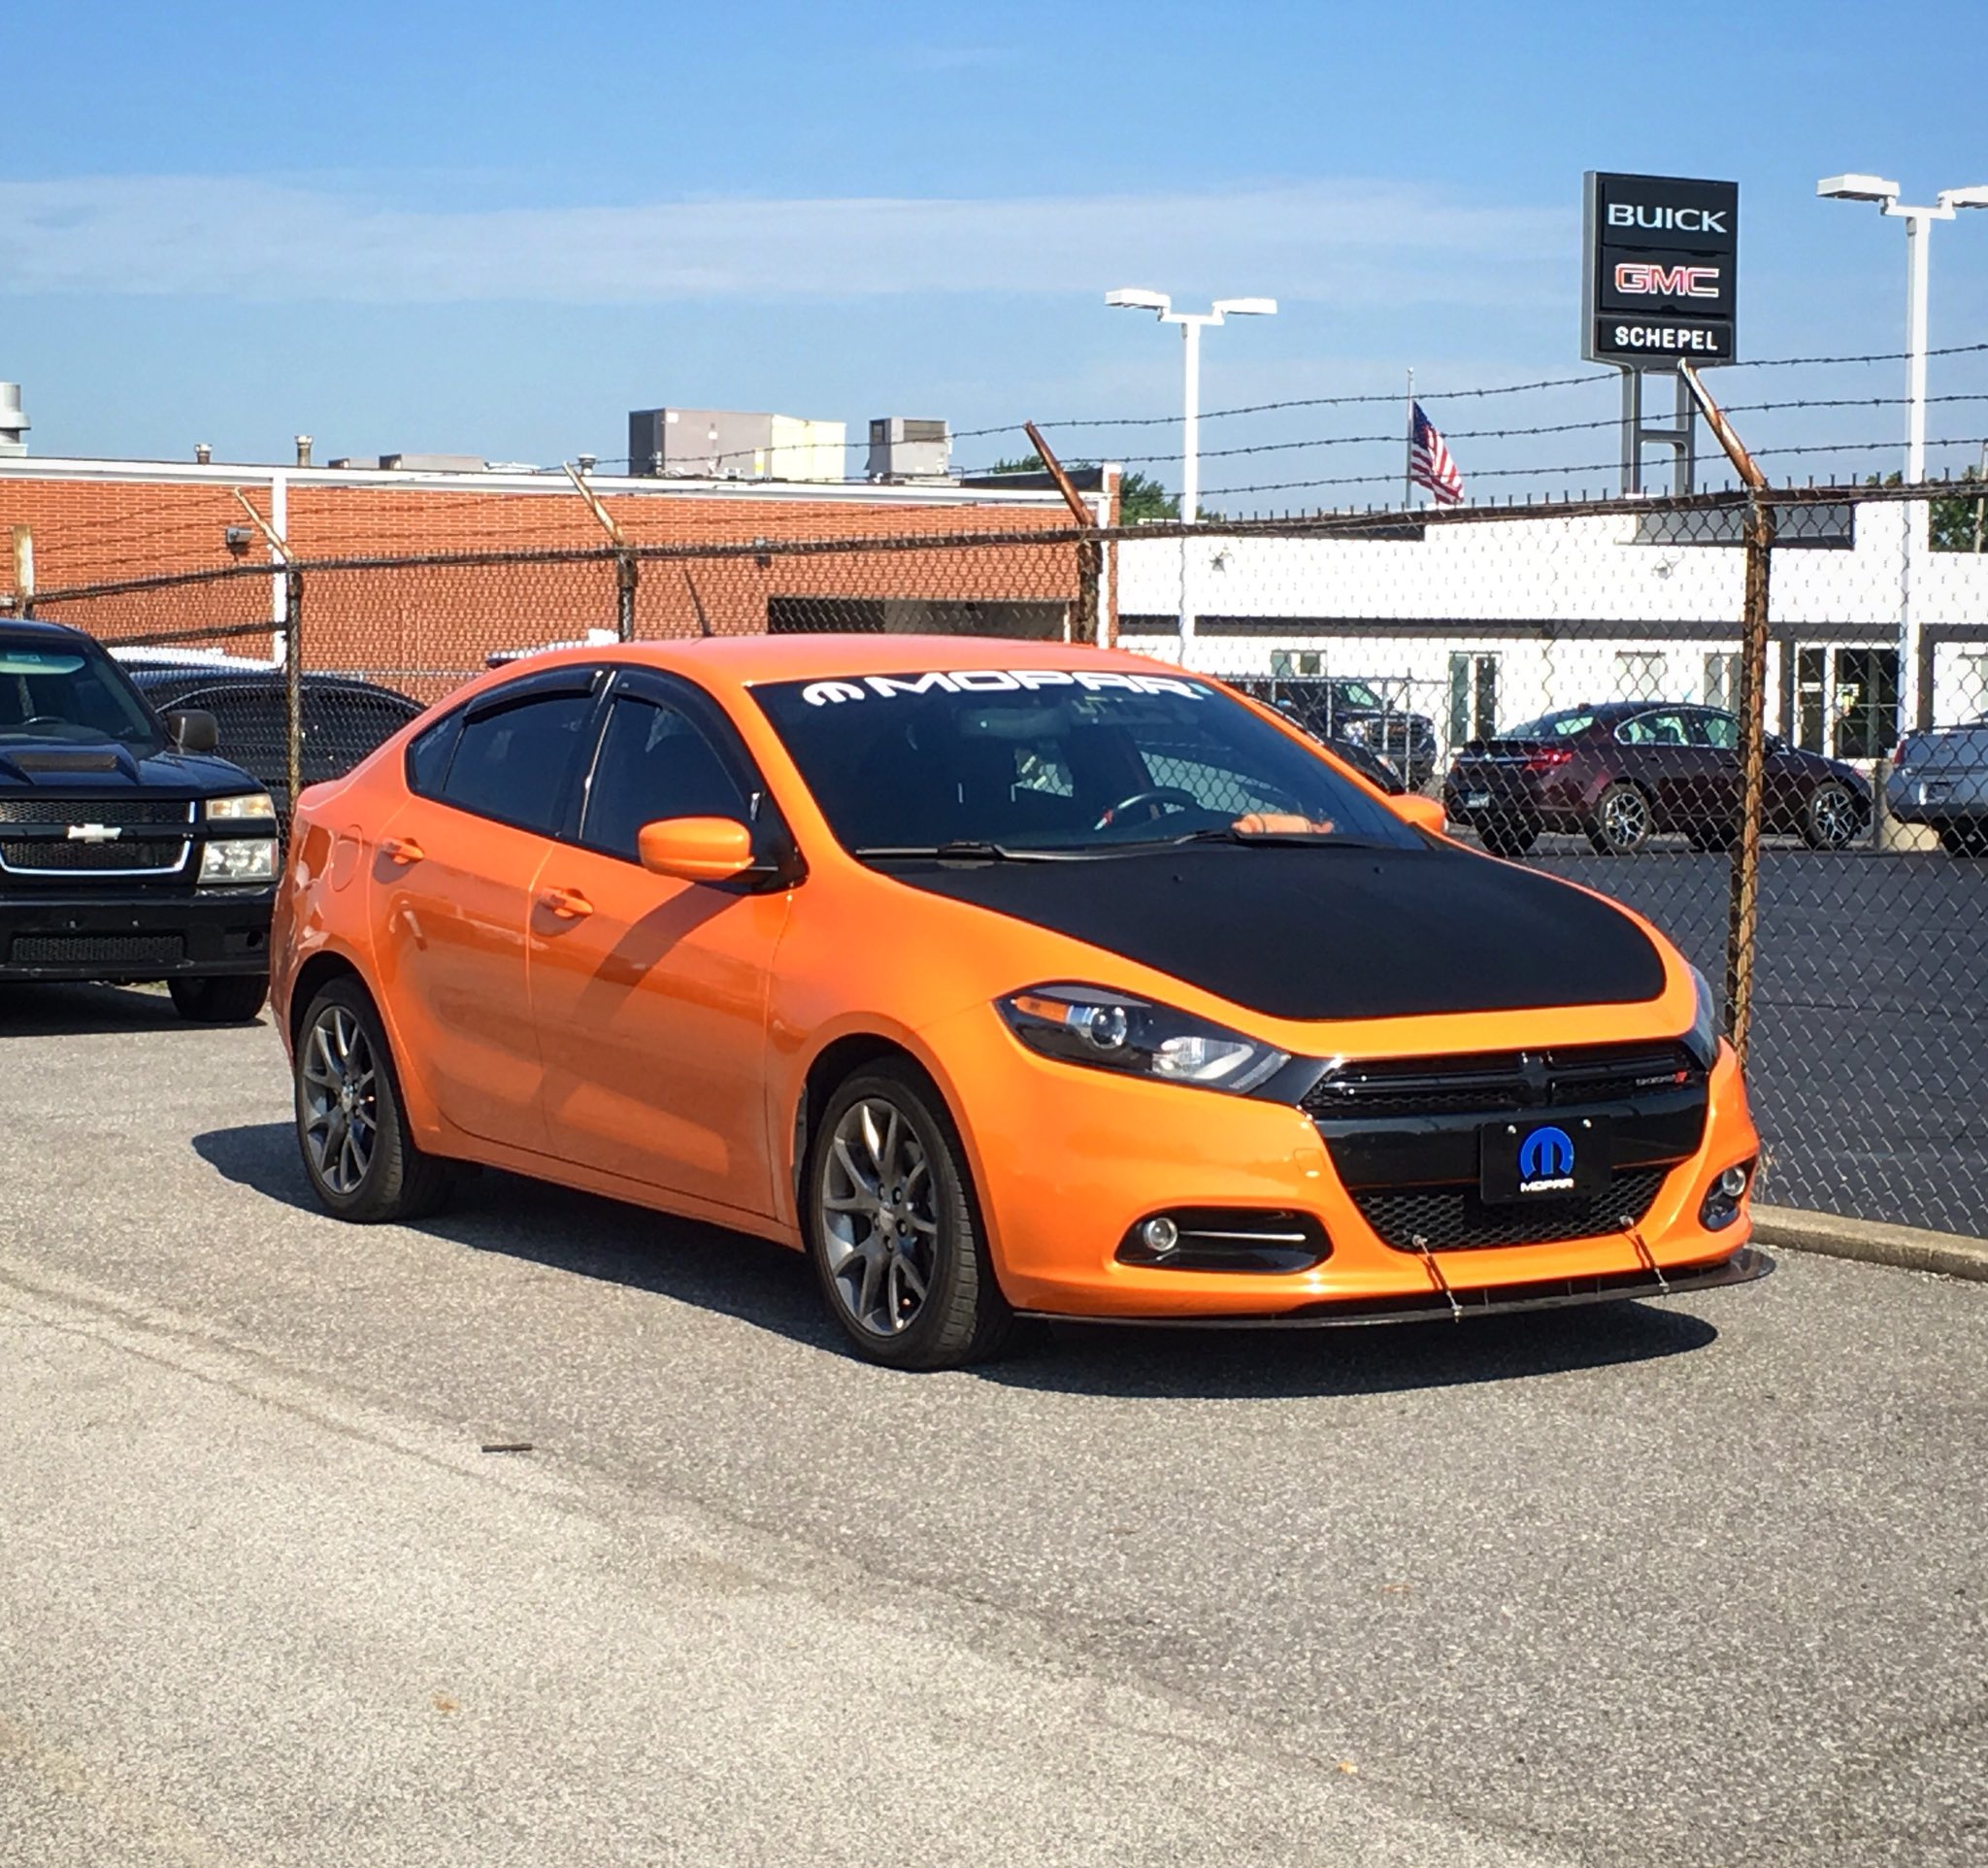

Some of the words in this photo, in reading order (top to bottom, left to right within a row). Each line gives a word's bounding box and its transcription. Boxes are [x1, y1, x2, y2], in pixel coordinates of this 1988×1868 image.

[1607, 203, 1727, 233] BUICK
[1614, 263, 1719, 298] GMC
[1615, 326, 1718, 350] SCHEPEL
[864, 670, 1205, 700] MOPAR
